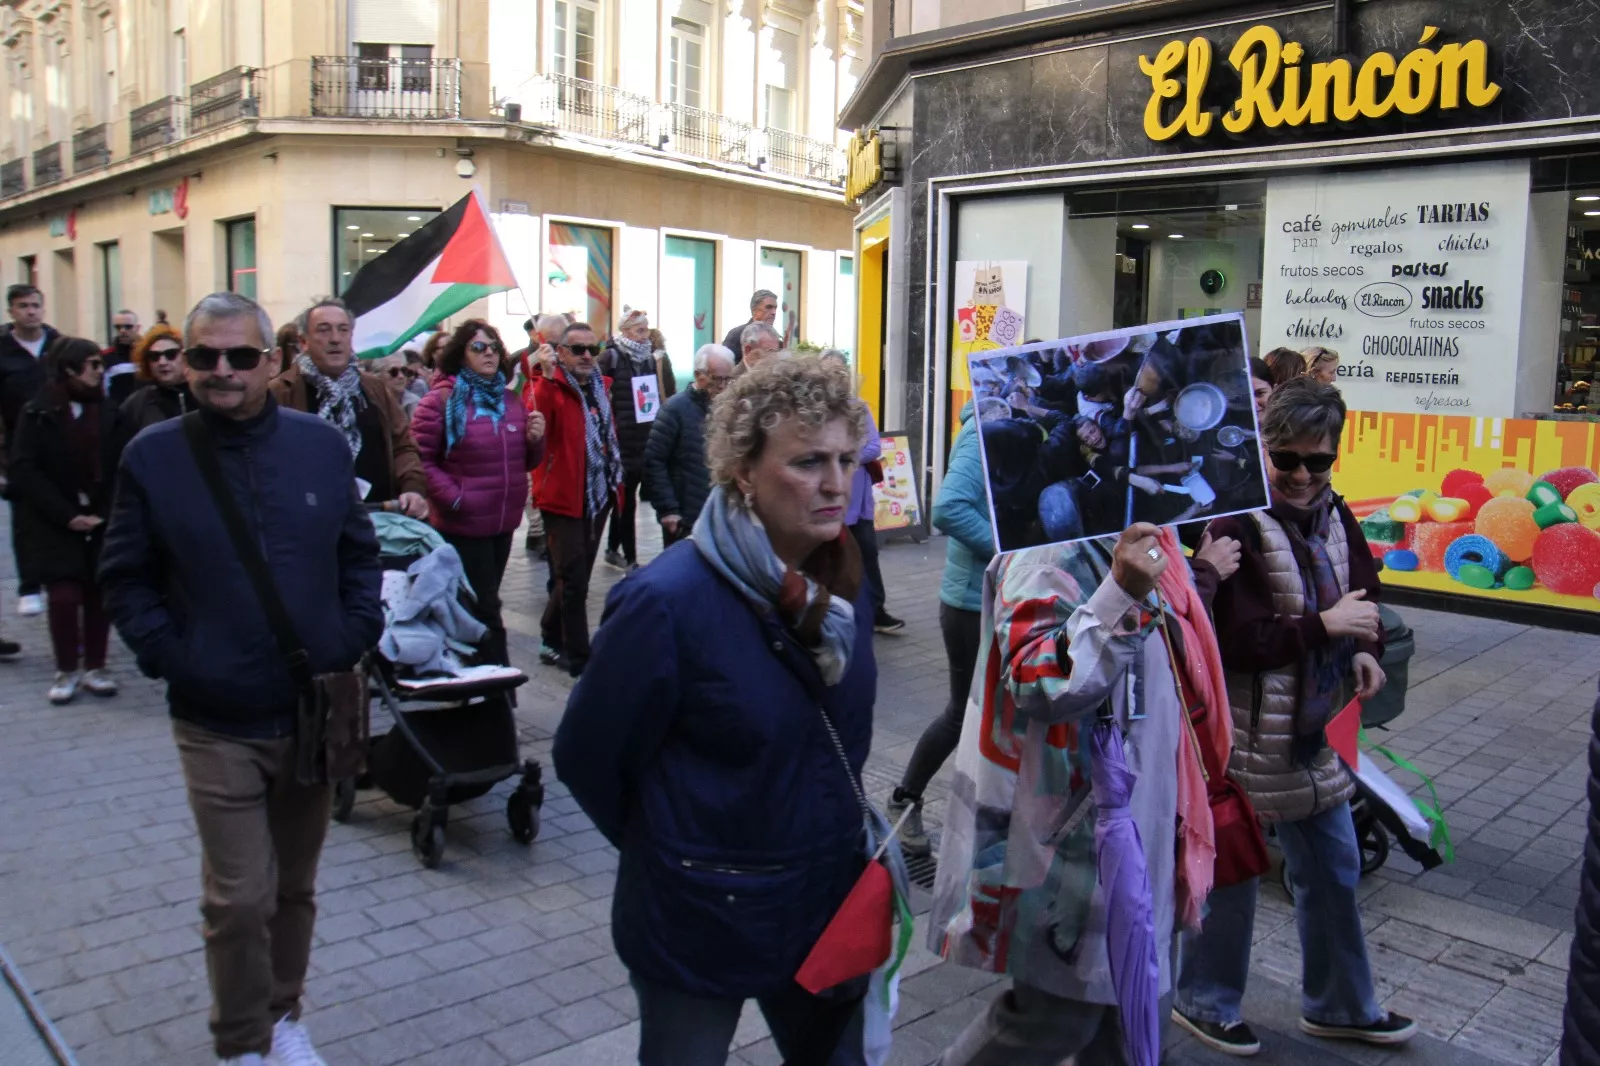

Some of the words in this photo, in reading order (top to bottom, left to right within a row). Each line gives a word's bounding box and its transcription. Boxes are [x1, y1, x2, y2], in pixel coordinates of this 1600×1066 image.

[1139, 37, 1211, 141] El
[1221, 25, 1502, 133] Rincón
[1282, 214, 1322, 233] café
[1417, 201, 1490, 224] TARTAS
[1292, 236, 1318, 252] pan
[1349, 241, 1403, 258] regalos
[1438, 232, 1489, 251] chicles
[1280, 264, 1319, 277] frutos
[1322, 265, 1364, 277] secos
[1391, 262, 1449, 278] pastas
[1361, 294, 1371, 307] El
[1372, 293, 1405, 307] Rincón
[1421, 279, 1484, 310] snacks
[1286, 317, 1343, 339] chicles
[1410, 317, 1445, 329] frutos
[1447, 319, 1486, 329] secos
[1362, 335, 1460, 358] CHOCOLATINAS
[1336, 360, 1375, 378] ería
[1386, 368, 1459, 385] REPOSTERÍA
[1415, 391, 1472, 410] refrescos
